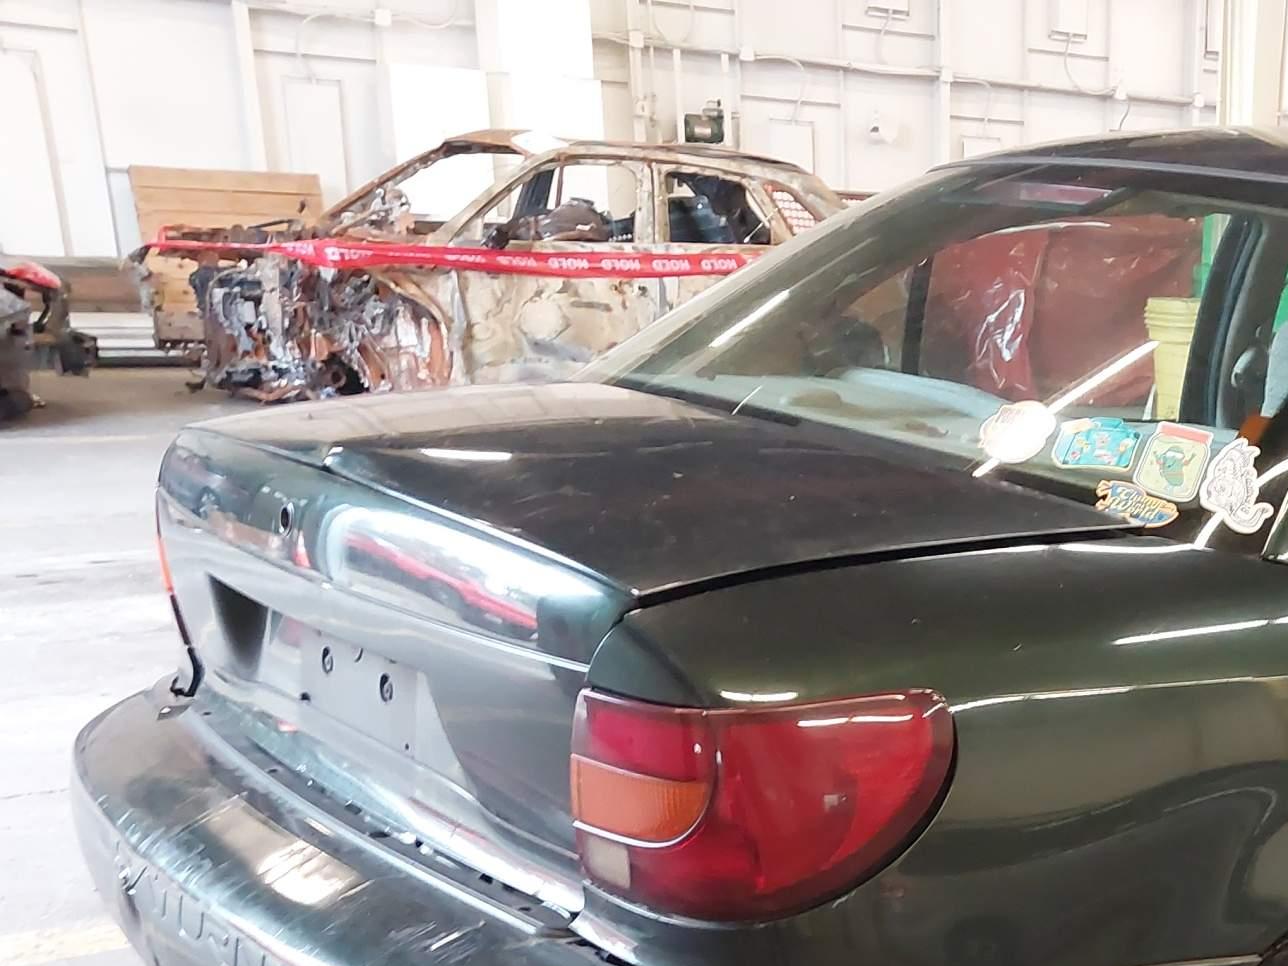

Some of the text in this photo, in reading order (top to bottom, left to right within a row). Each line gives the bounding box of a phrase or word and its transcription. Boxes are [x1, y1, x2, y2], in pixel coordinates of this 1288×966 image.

[548, 256, 589, 270] HOLD
[601, 257, 640, 271] HOLD
[652, 257, 690, 271] HOLD
[701, 257, 737, 271] HOLD
